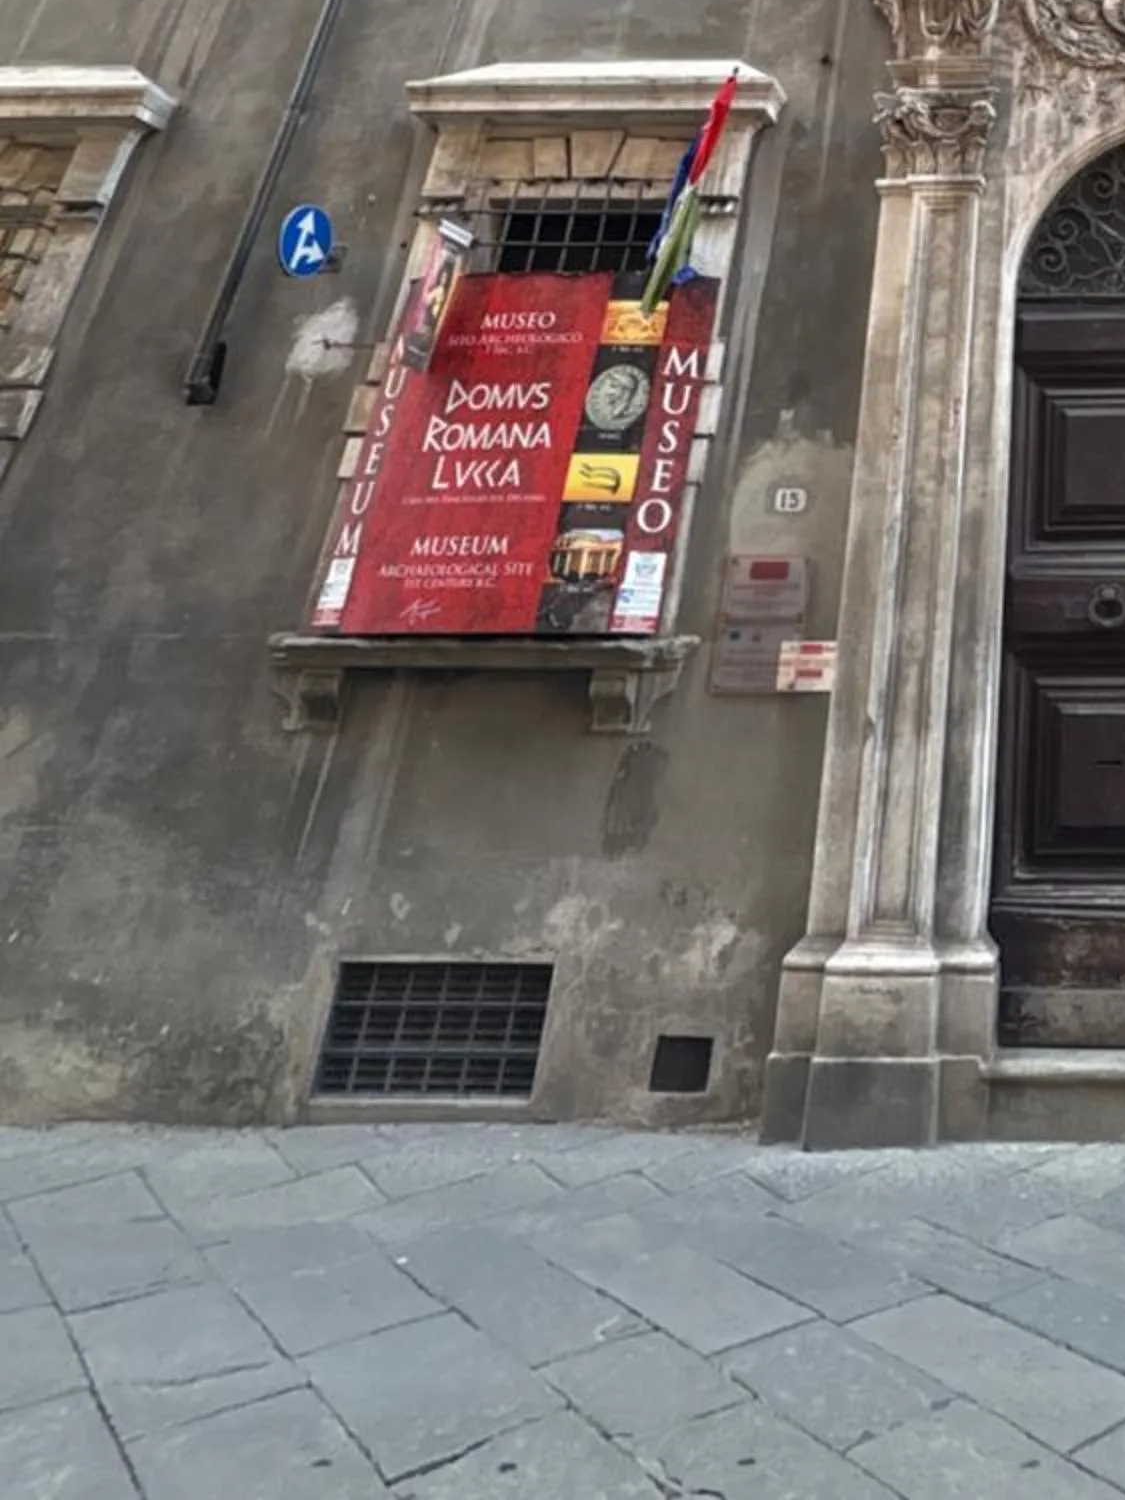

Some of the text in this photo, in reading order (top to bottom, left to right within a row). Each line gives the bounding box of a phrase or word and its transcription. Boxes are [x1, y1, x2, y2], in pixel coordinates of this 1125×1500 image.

[479, 310, 557, 330] MUSEO
[444, 379, 552, 415] DOMVS
[421, 414, 552, 453] ROMANA
[637, 346, 698, 534] MUSEO
[409, 534, 510, 557] MUSEUM
[502, 560, 535, 577] SITE
